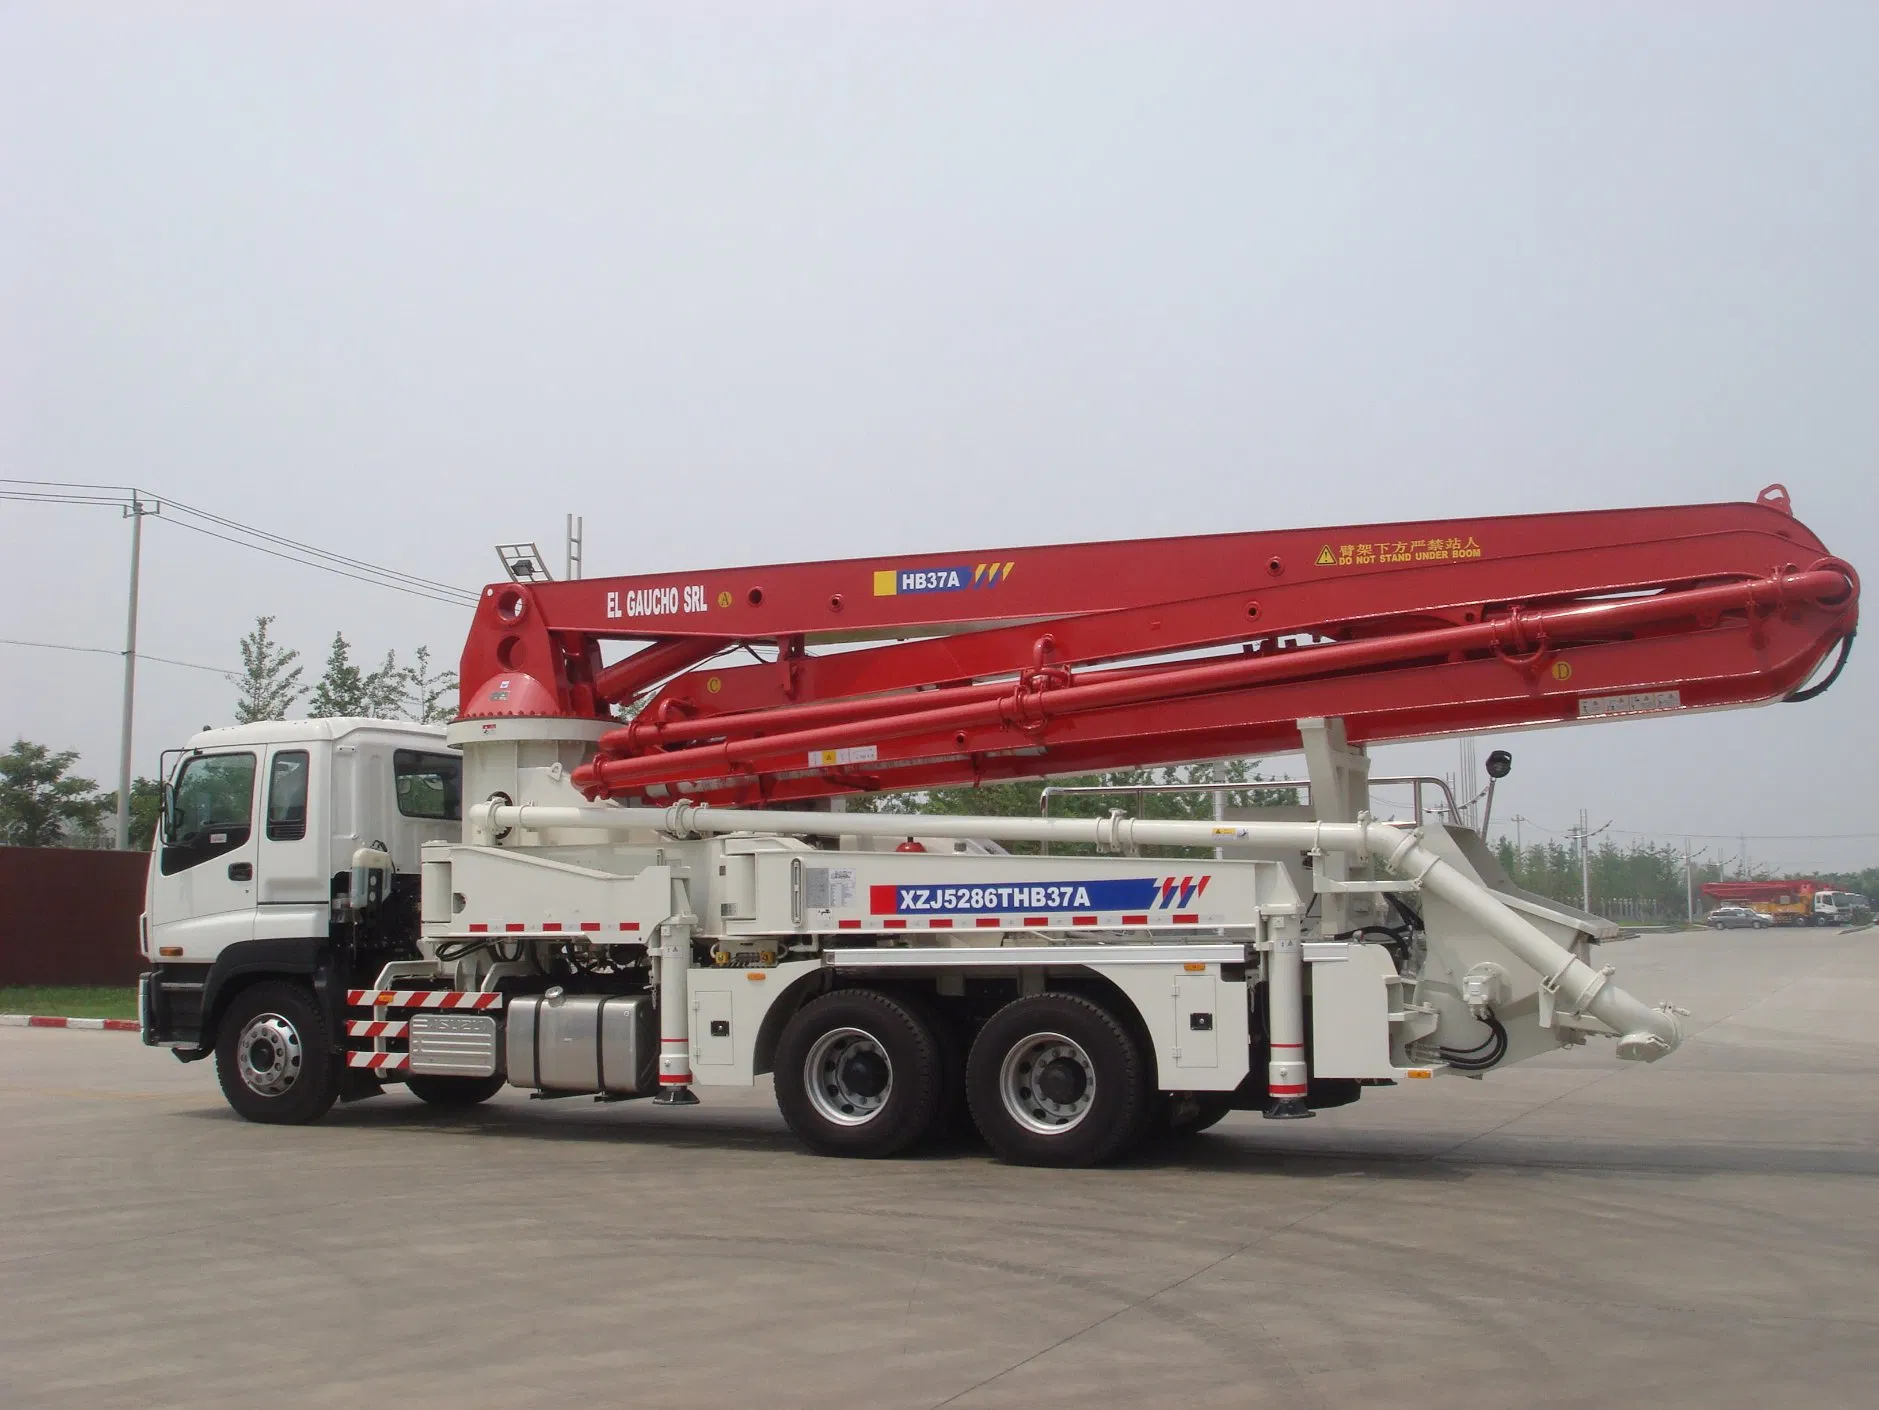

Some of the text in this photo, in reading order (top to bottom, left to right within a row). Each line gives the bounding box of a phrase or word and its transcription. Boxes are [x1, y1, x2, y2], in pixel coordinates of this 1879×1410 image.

[1339, 536, 1479, 557] 臂架下方严禁站人
[1339, 548, 1481, 565] DO NOT STAND UNDER BOOM
[902, 571, 960, 590] HB37A
[607, 585, 708, 618] EL GAUCHO SRL
[900, 886, 1091, 909] XZJ5286THB37A
